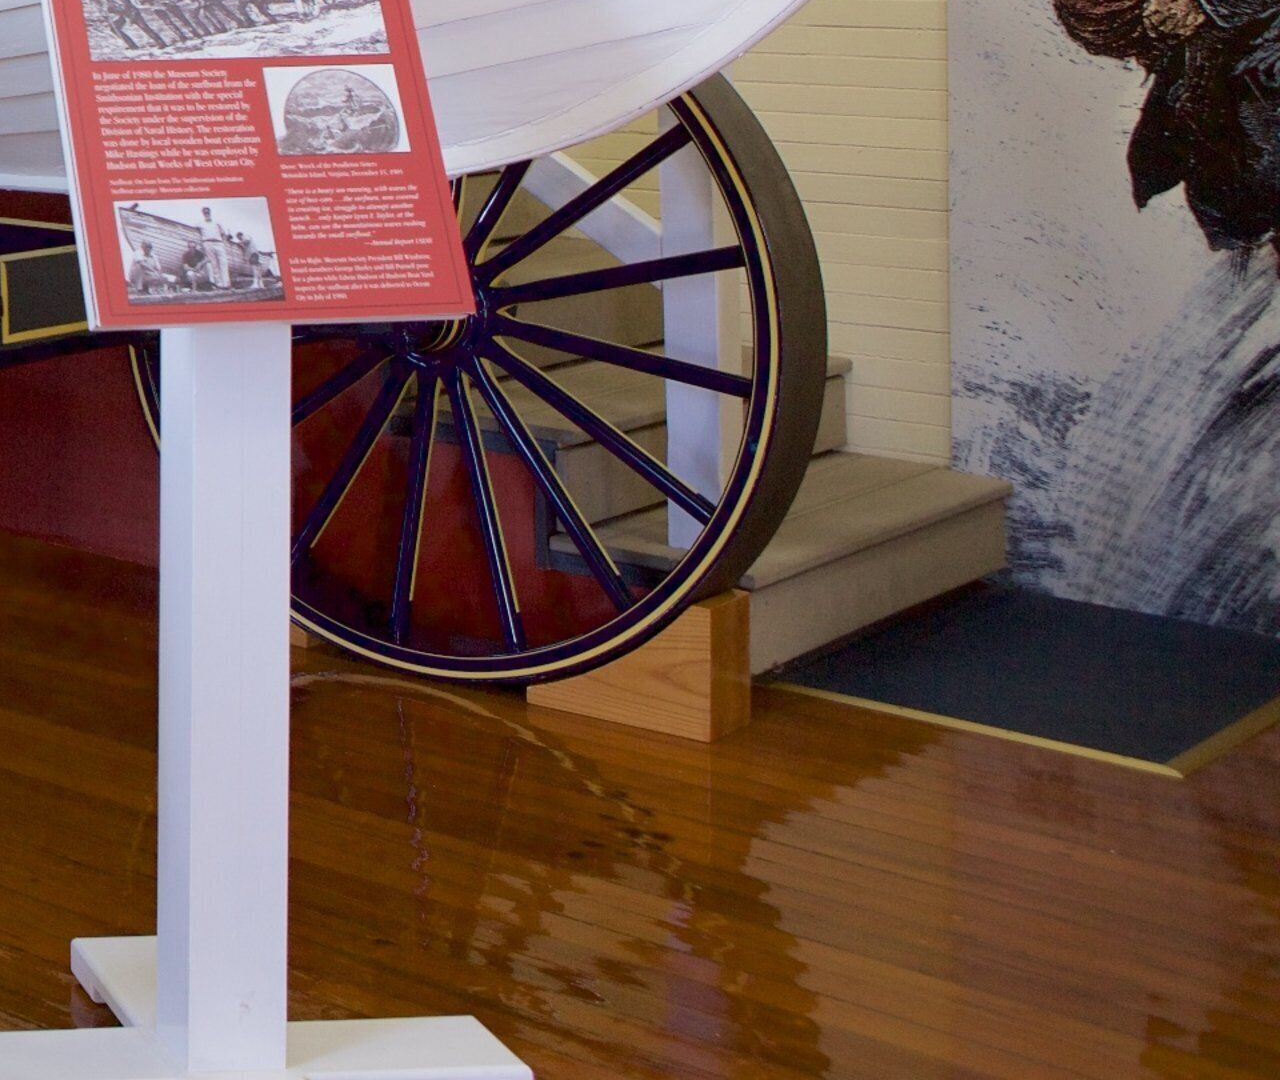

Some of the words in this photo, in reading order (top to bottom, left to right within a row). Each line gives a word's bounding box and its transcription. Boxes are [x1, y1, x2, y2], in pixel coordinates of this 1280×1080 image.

[102, 72, 119, 80] June
[153, 70, 164, 78] the
[167, 69, 199, 77] Museum
[201, 69, 228, 78] Society
[93, 82, 133, 91] negotiated
[148, 81, 165, 89] loan
[191, 80, 222, 88] surfboat
[223, 79, 242, 87] from
[94, 93, 142, 101] Smithsonian
[144, 92, 182, 100] Institution
[202, 91, 214, 99] the
[216, 90, 244, 100] special
[96, 104, 145, 114] requirement
[207, 102, 239, 110] restored
[241, 102, 250, 110] by
[98, 116, 111, 124] the
[113, 116, 139, 124] Society
[166, 114, 178, 122] the
[180, 113, 224, 123] supervision
[100, 127, 132, 135] Division
[144, 126, 164, 134] Naval
[166, 125, 194, 134] History.
[213, 124, 255, 132] restoration
[119, 138, 138, 146] done
[140, 138, 149, 146] by
[151, 137, 170, 145] local
[204, 136, 221, 144] boat
[222, 135, 261, 143] craftsman
[104, 150, 124, 158] Mike
[126, 149, 158, 158] Hastings
[160, 148, 180, 156] while
[182, 148, 191, 156] he
[210, 147, 247, 156] employed
[249, 146, 258, 155] by
[105, 161, 136, 169] Hudson
[138, 160, 156, 168] Boat
[213, 158, 238, 166] Ocean
[239, 158, 254, 166] City.
